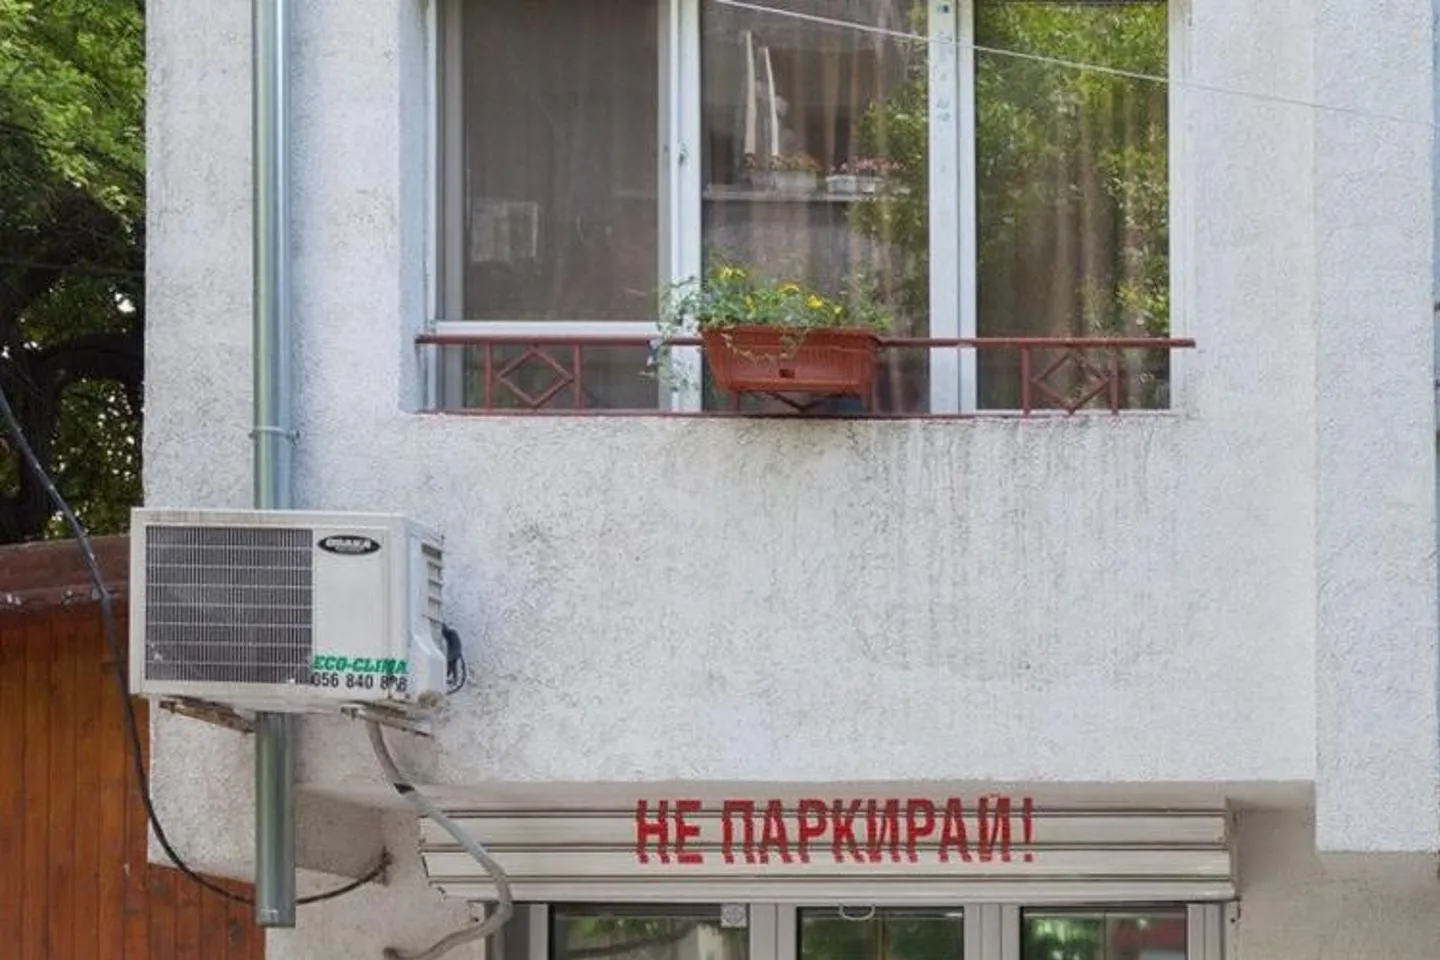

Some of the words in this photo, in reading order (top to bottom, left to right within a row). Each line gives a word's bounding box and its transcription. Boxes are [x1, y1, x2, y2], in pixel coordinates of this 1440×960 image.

[312, 655, 408, 674] ECO-CLIMA
[345, 673, 374, 690] 840
[636, 799, 703, 864] НЕ
[721, 794, 1034, 864] ПАРКИРАЙ!
